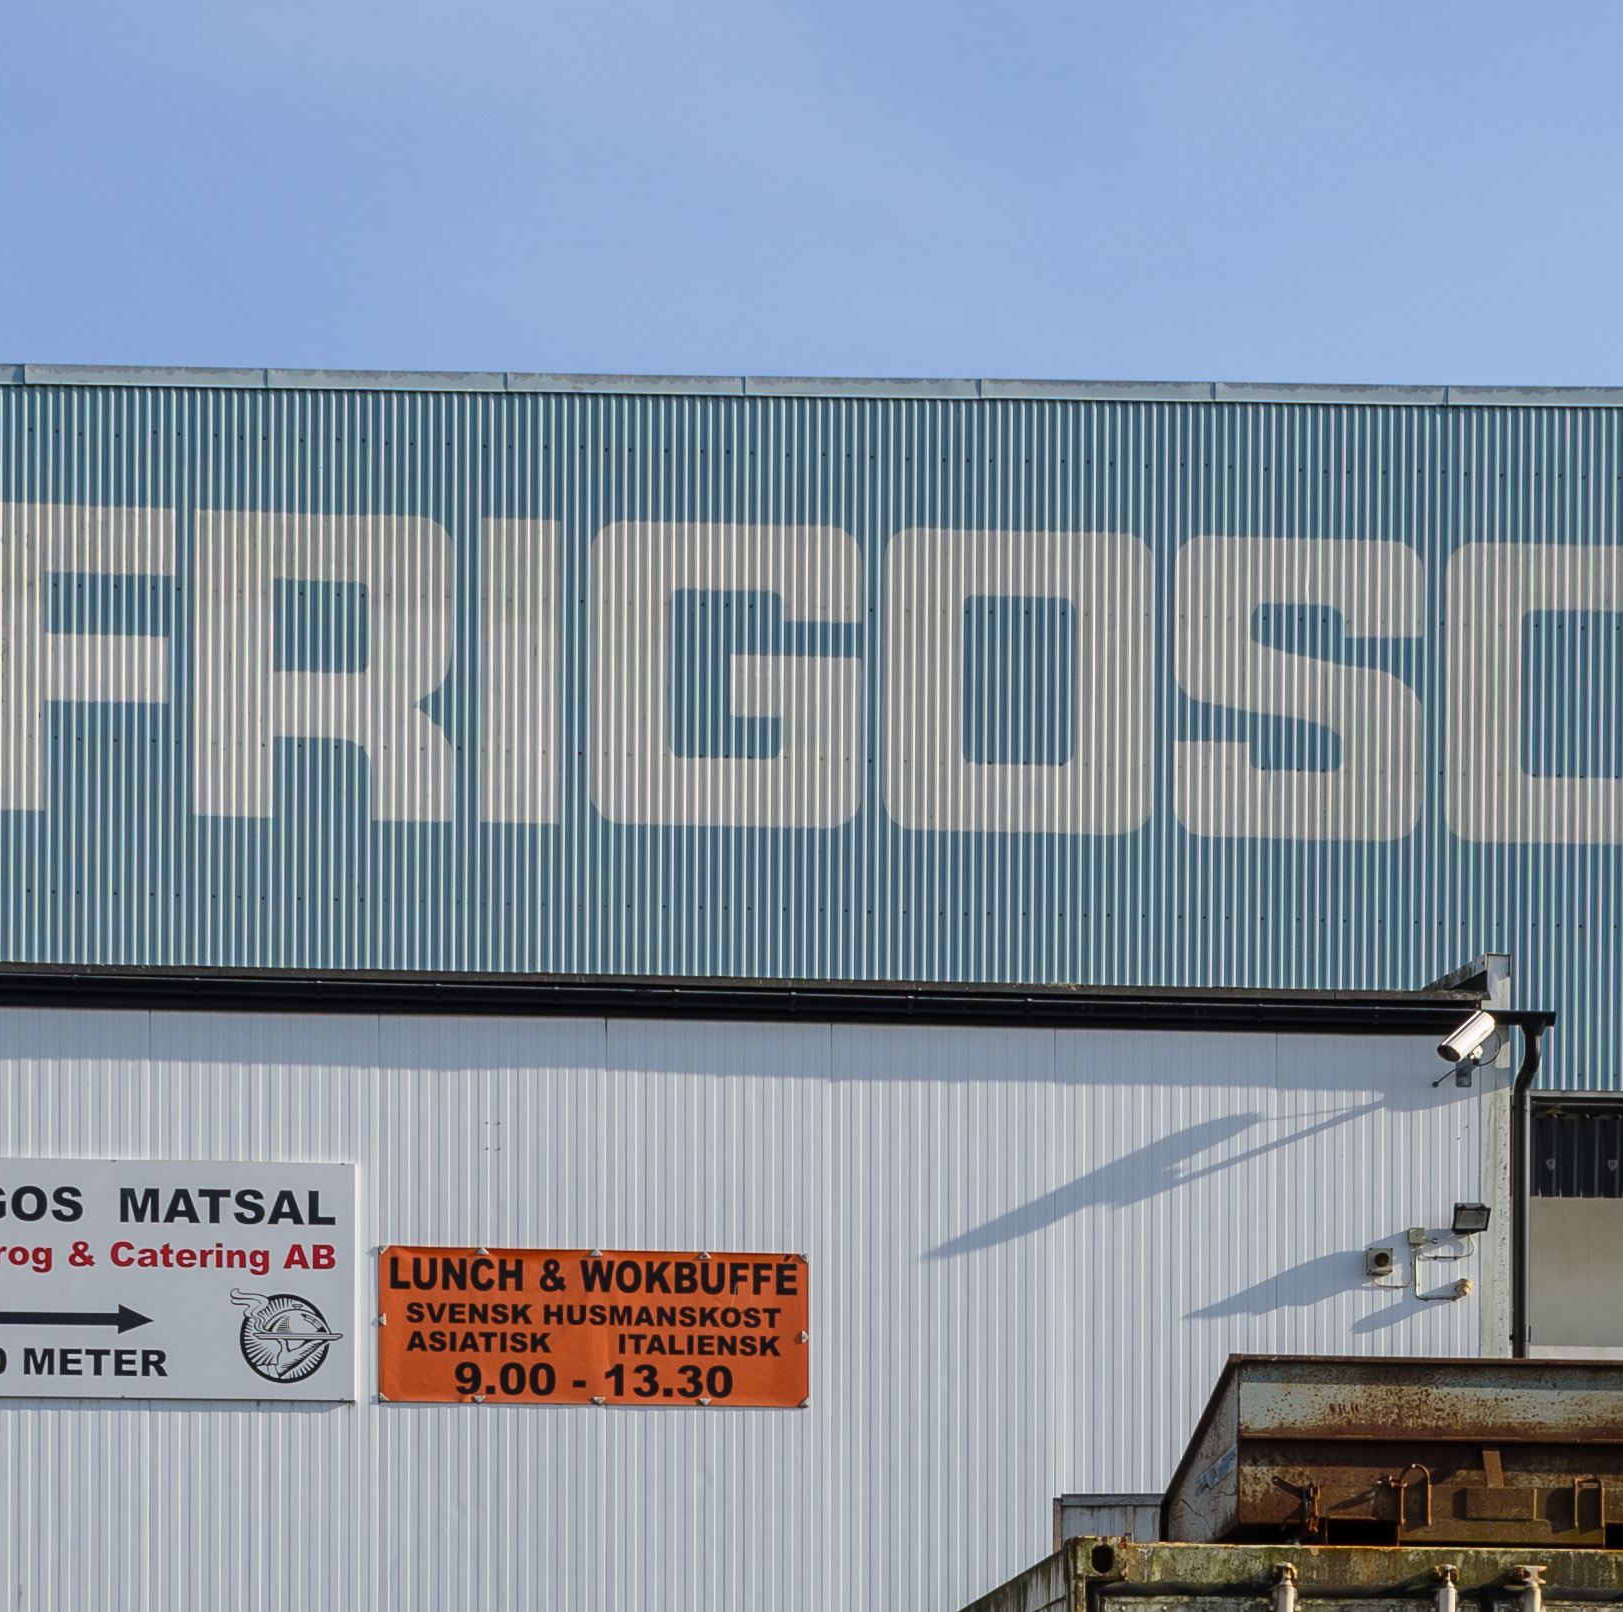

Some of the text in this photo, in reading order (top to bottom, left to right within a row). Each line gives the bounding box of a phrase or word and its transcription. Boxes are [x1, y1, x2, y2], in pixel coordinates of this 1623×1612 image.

[119, 1187, 336, 1227] MATSAL
[68, 1241, 96, 1268] &
[110, 1241, 270, 1276] Catering
[283, 1243, 336, 1270] AB
[389, 1255, 799, 1296] LUNCH & WOKBUFFÉ
[405, 1302, 782, 1329] SVENSK HUSMANSKOST
[406, 1331, 781, 1357] ASIATISK ITALIENSK
[23, 1348, 169, 1378] METER
[454, 1361, 734, 1398] 9.00 - 13.30
